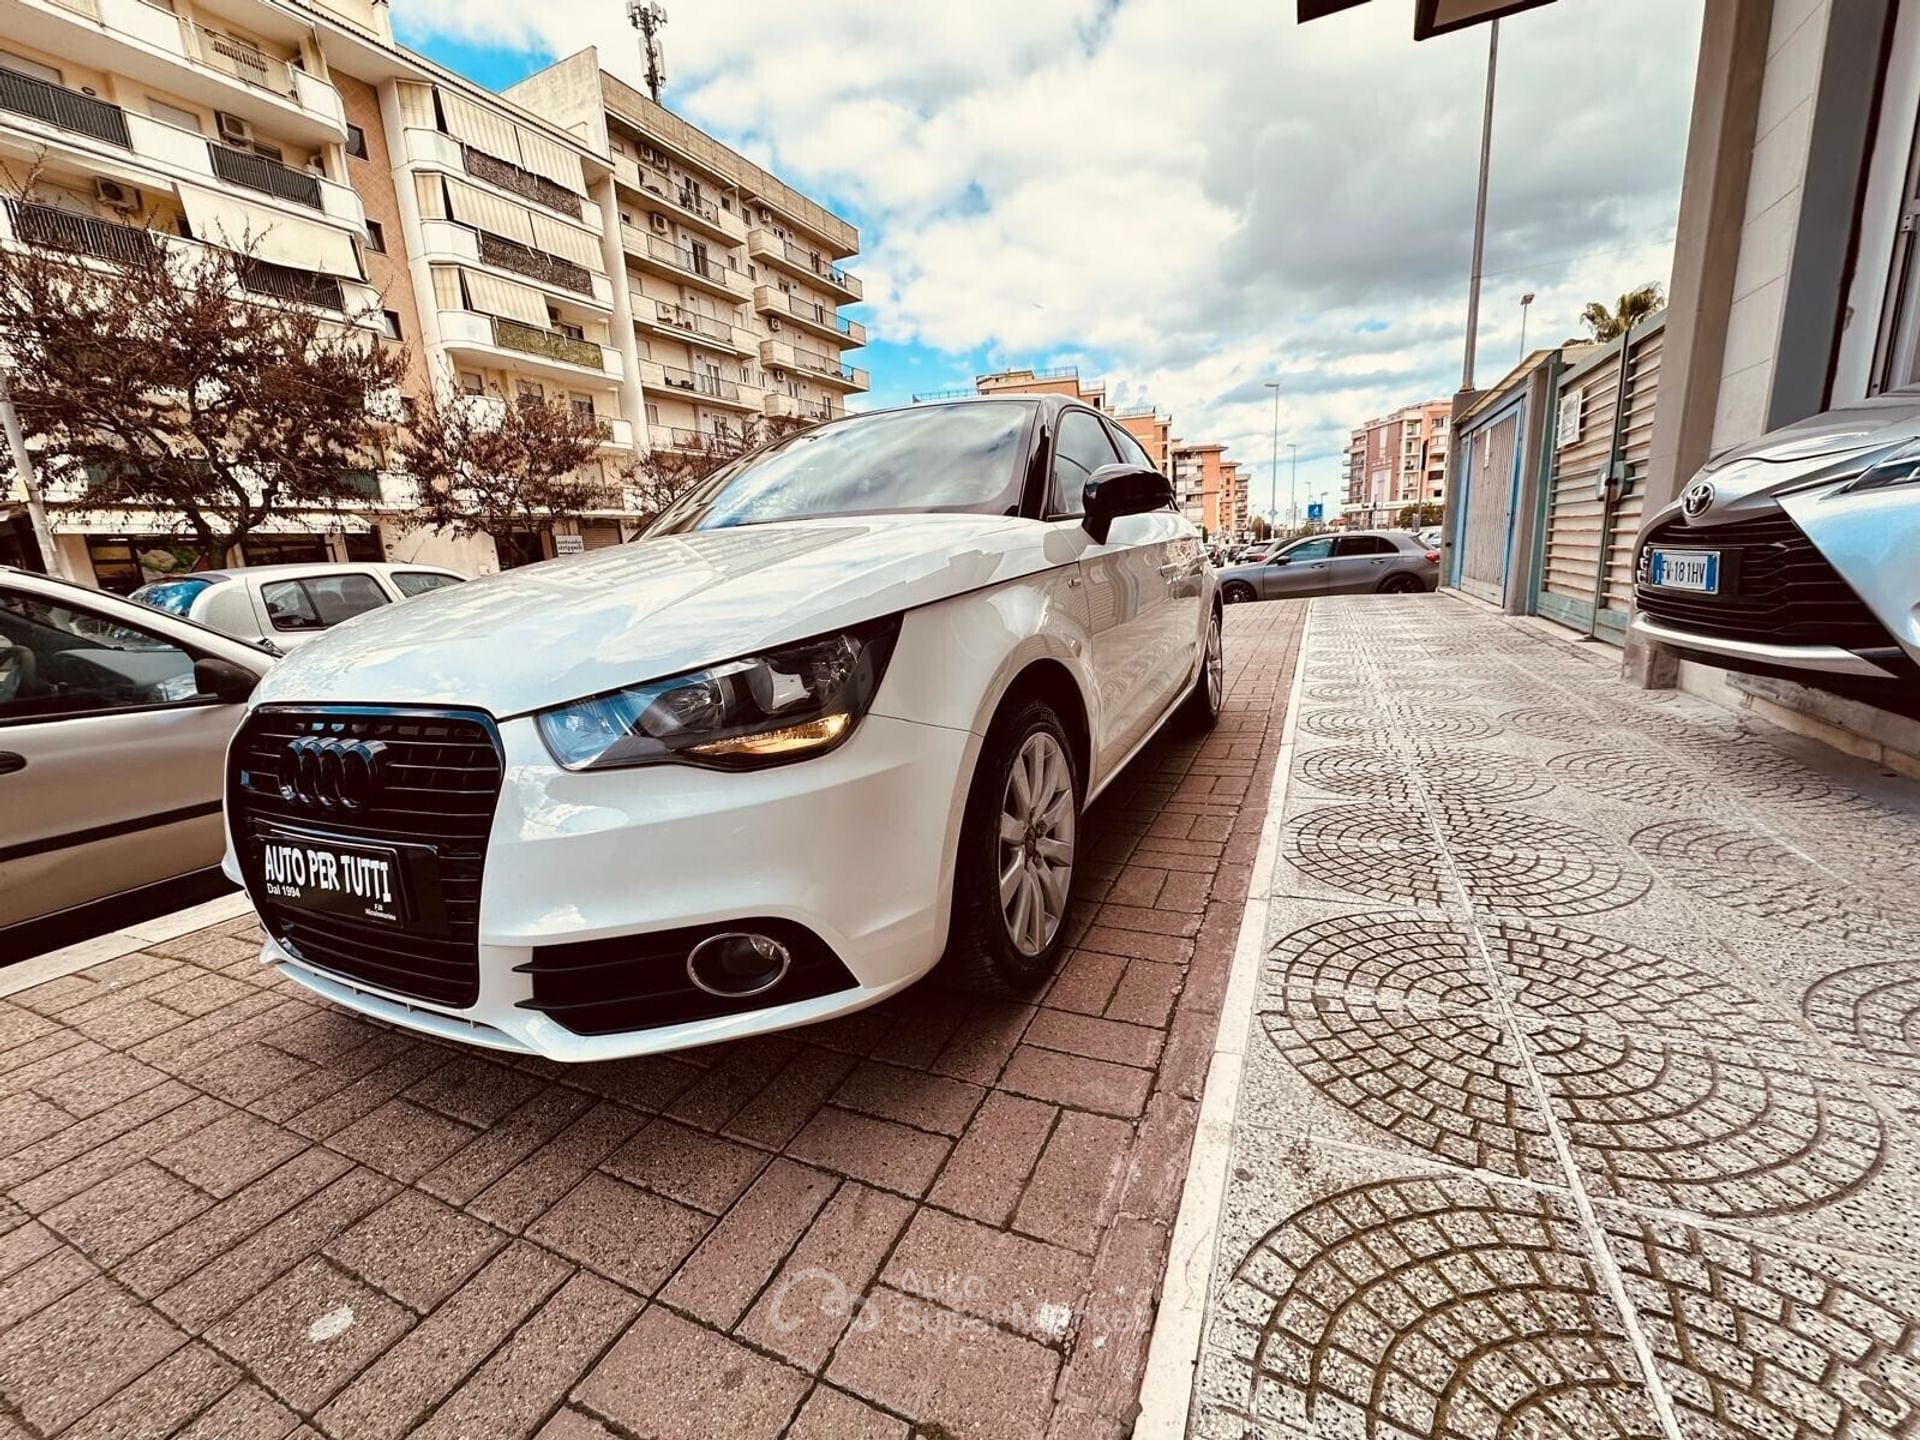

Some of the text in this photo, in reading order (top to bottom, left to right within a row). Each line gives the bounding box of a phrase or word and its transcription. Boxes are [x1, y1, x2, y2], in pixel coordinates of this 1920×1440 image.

[265, 844, 392, 903] AUTO PER TUTTI
[266, 883, 301, 898] Dal 1994
